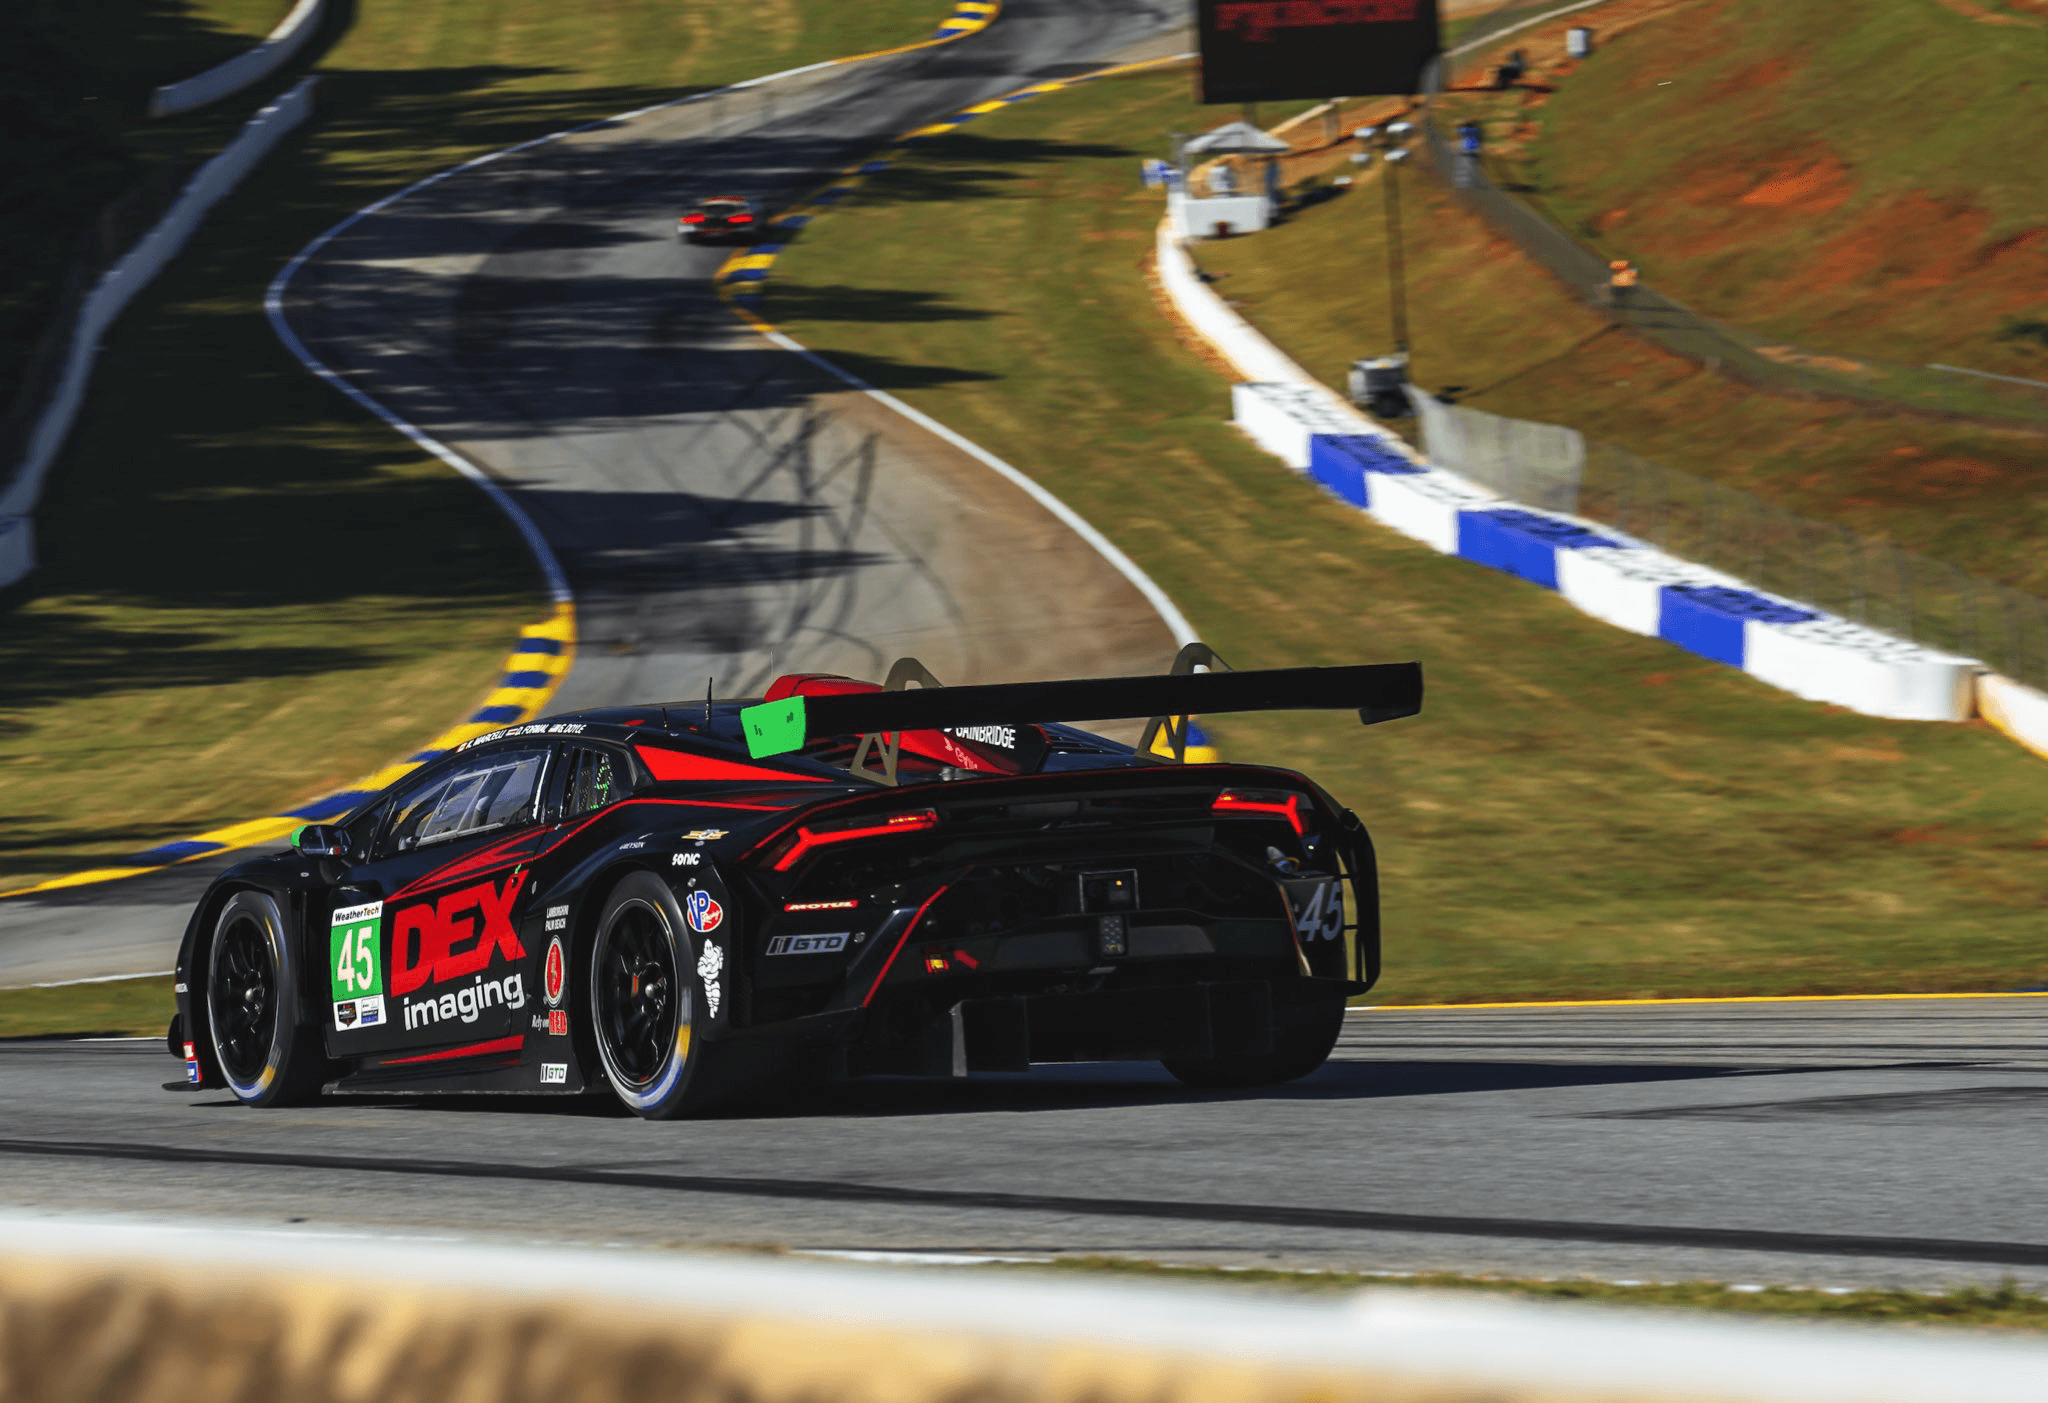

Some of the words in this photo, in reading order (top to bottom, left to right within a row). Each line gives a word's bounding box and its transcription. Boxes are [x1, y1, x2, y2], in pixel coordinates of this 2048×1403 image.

[335, 906, 380, 921] WeatherTech
[390, 869, 530, 998] DEX
[789, 901, 852, 911] MOTUL
[1297, 881, 1342, 942] 45
[337, 926, 374, 992] 45
[404, 973, 526, 1031] imaging
